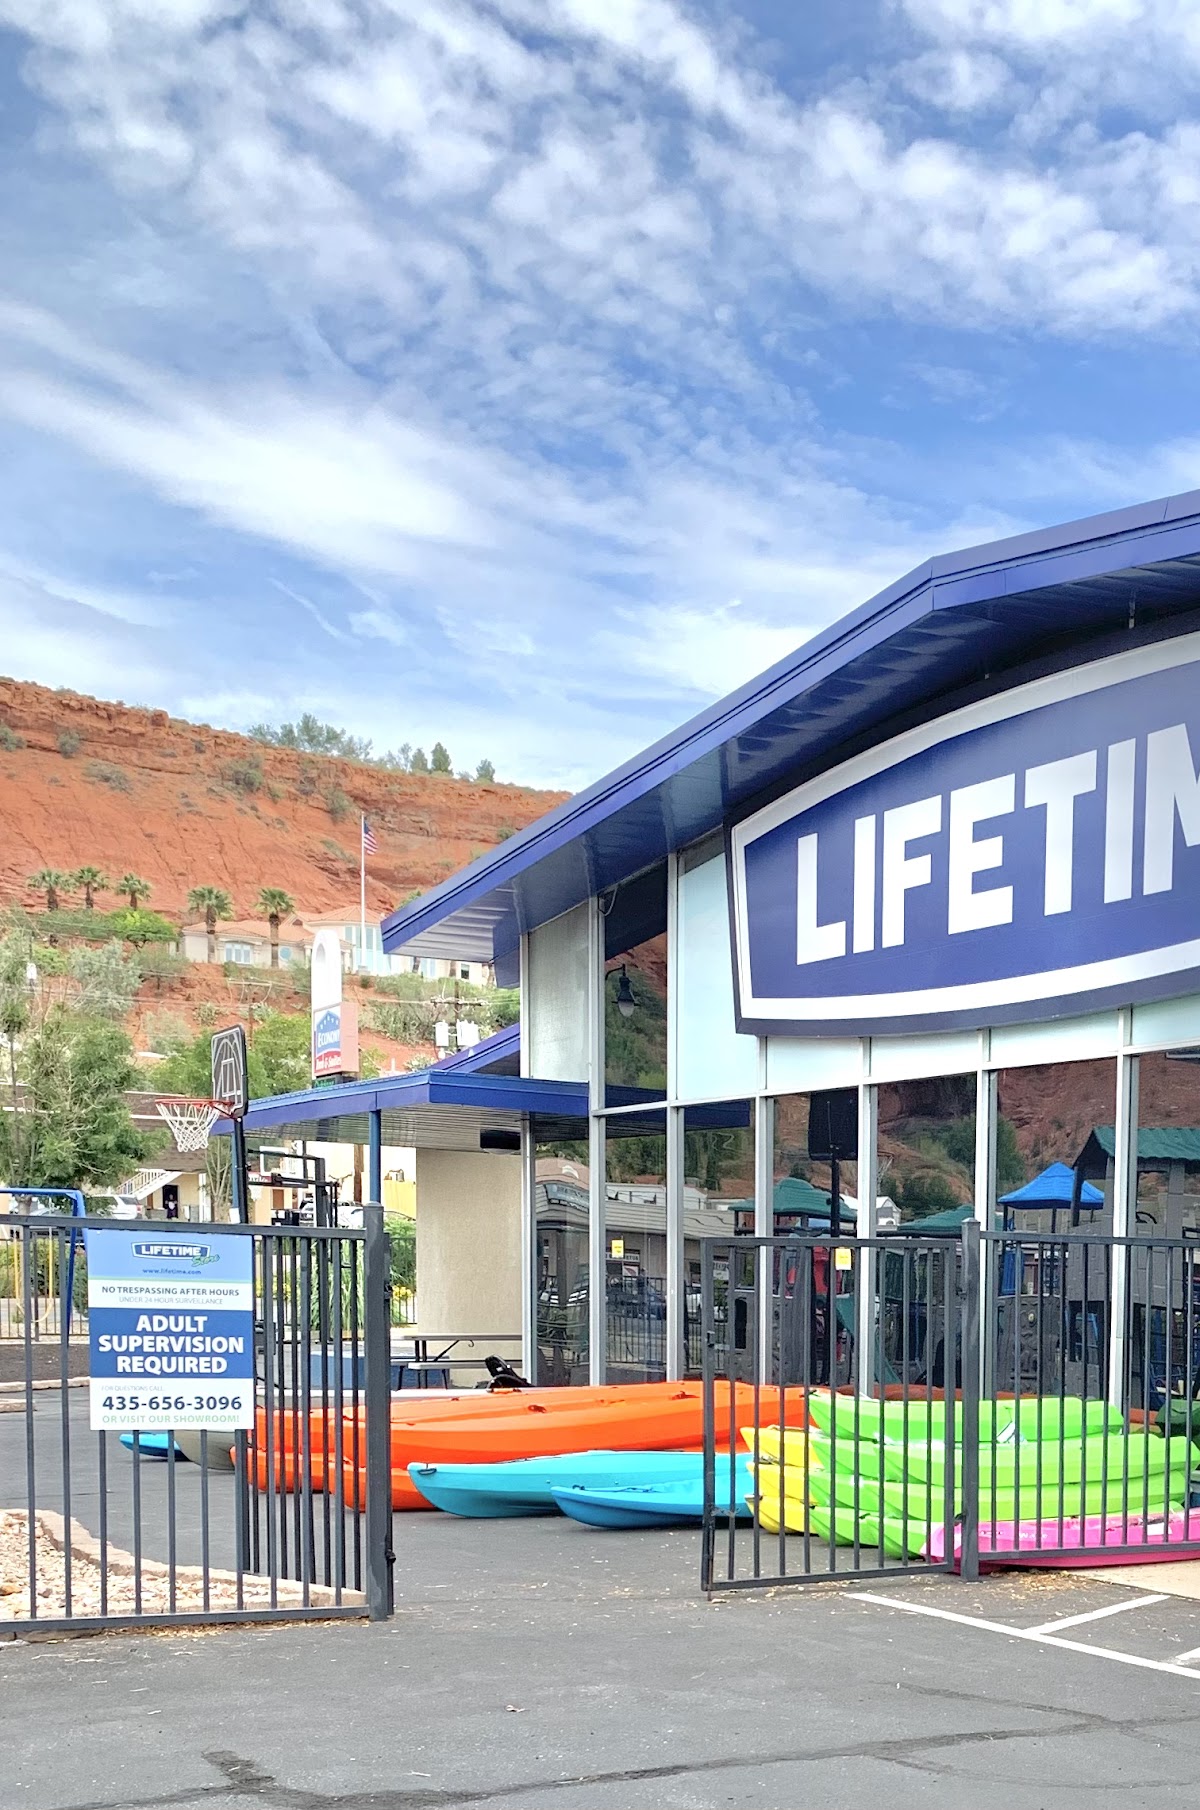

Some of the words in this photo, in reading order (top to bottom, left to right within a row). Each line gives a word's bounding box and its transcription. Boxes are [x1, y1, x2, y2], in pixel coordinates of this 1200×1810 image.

[141, 1245, 201, 1256] LIFETIME
[191, 1255, 220, 1267] Store
[117, 1286, 178, 1295] TRESPASSING
[209, 1288, 239, 1296] HOURS
[175, 1297, 223, 1305] SURVEILLANCE
[136, 1314, 208, 1332] ADULT
[98, 1334, 244, 1353] SUPERVISION
[116, 1355, 228, 1375] REQUIRED
[102, 1396, 242, 1410] 435-656-3096
[102, 1415, 117, 1423] OR
[119, 1415, 148, 1423] VISIT
[149, 1415, 171, 1423] OUR
[173, 1415, 240, 1423] SHOWROOM!
